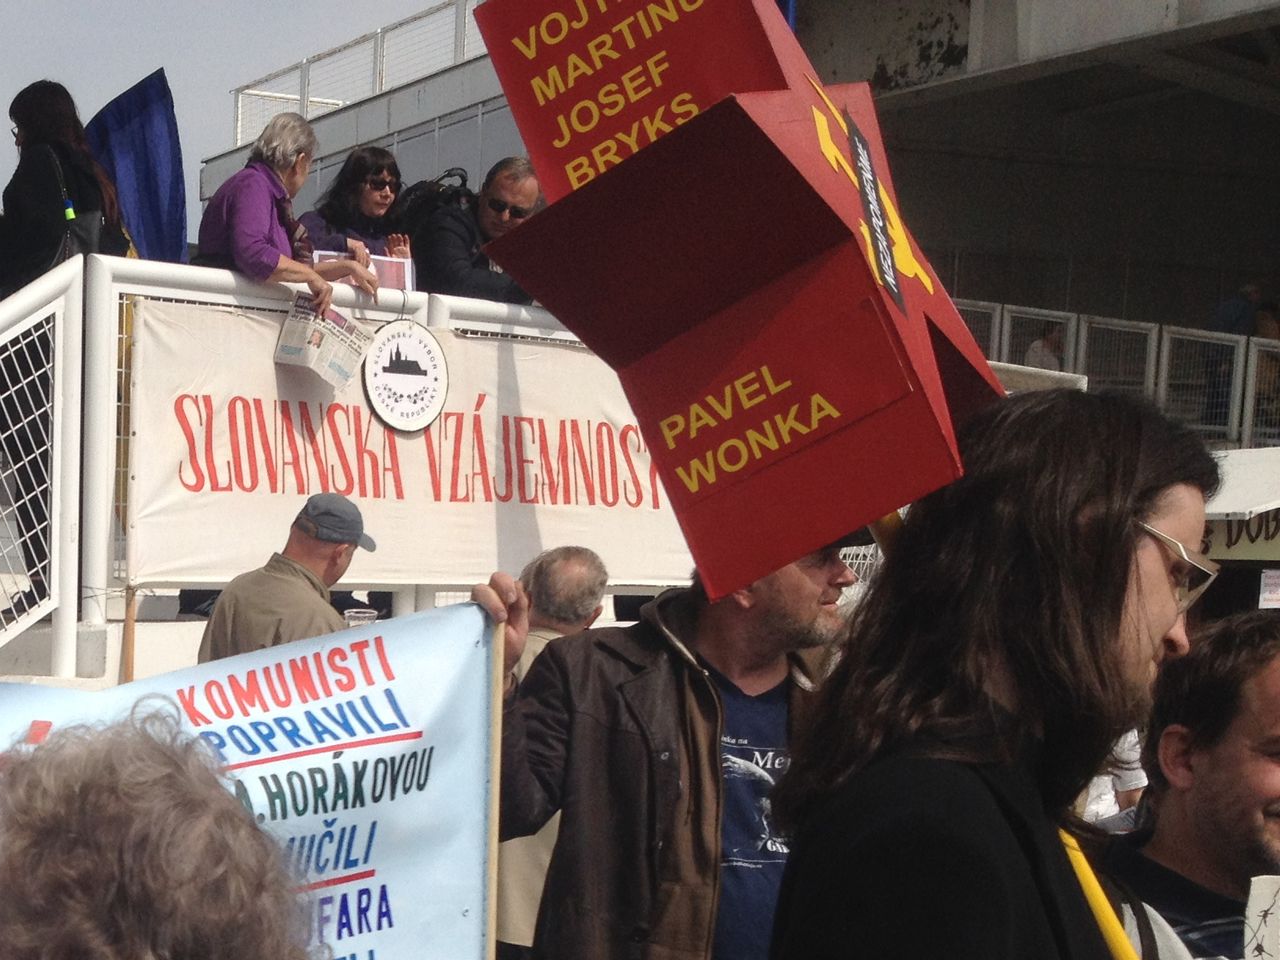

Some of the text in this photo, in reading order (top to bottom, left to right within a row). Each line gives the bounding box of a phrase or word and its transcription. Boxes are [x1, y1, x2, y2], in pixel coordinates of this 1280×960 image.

[552, 50, 670, 149] JOSEF
[564, 92, 700, 191] BRYKS
[659, 364, 792, 450] PAVEL
[675, 392, 841, 494] WONKA
[176, 635, 395, 727] KOMUNISTI
[200, 688, 410, 762] POPRAVILI
[302, 884, 394, 944] FARA
